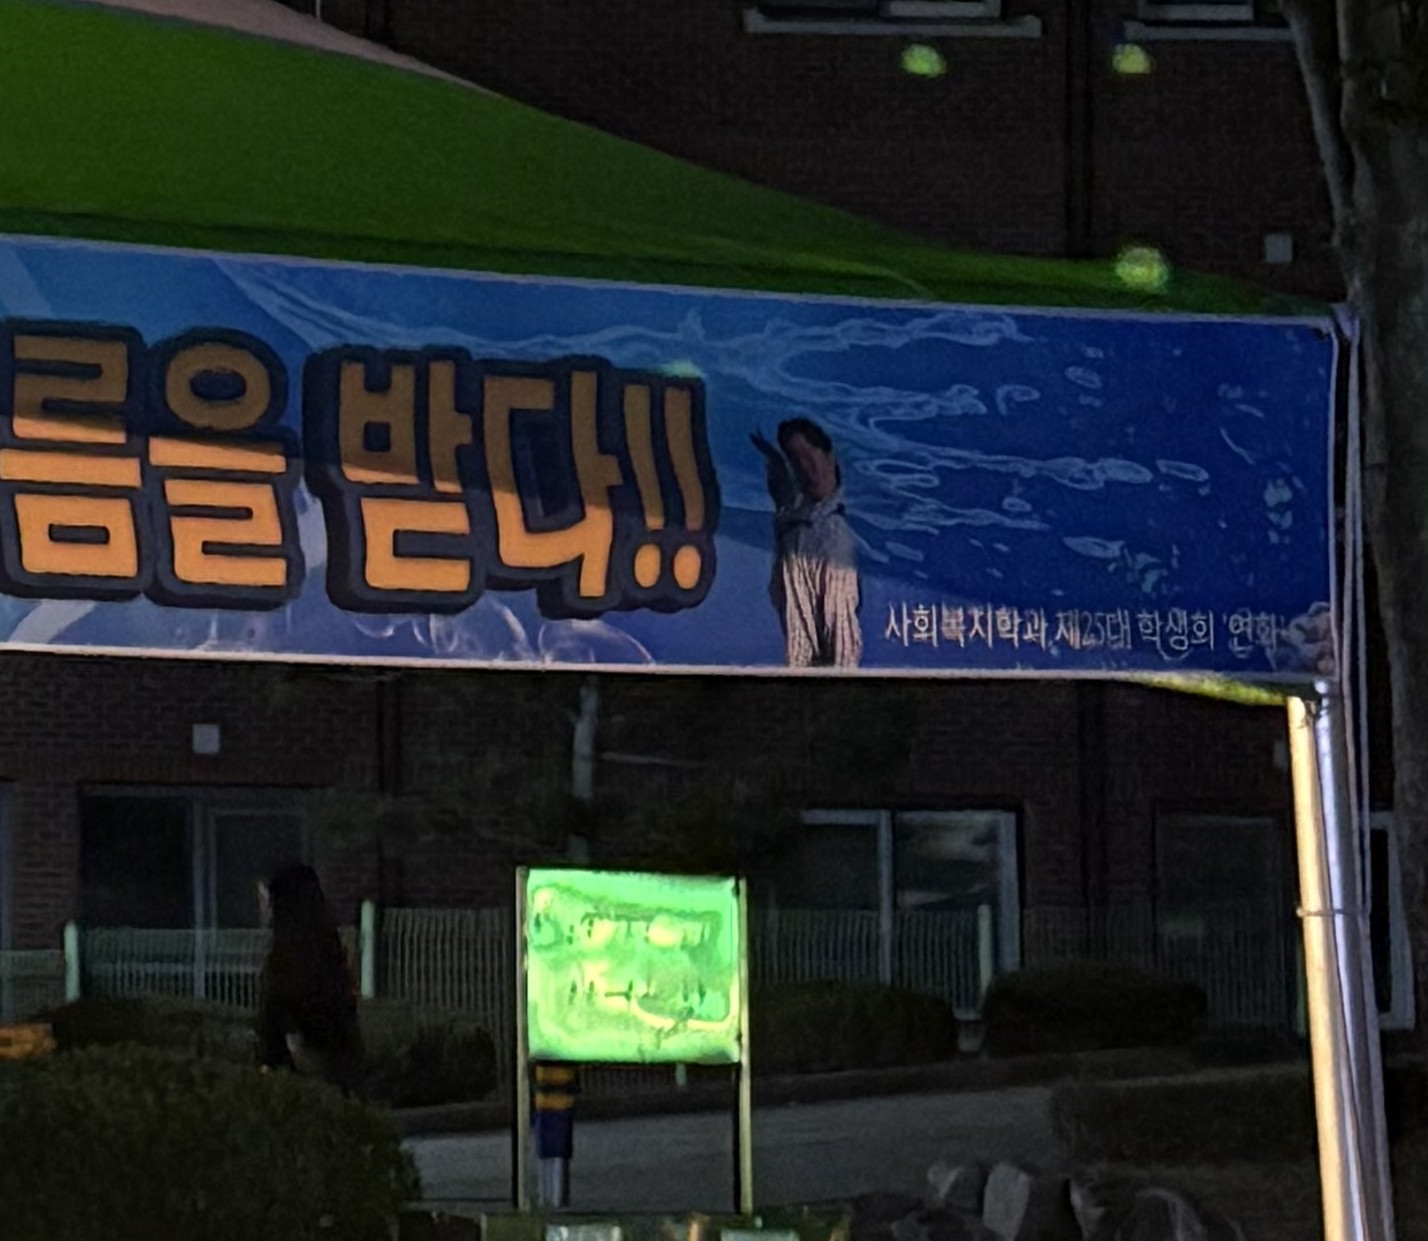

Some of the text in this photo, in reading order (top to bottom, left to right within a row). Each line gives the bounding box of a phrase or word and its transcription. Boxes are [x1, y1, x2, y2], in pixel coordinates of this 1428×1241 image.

[332, 346, 715, 608] 받다!!
[884, 602, 1048, 650] 사회복지학과
[1054, 607, 1132, 650] 제25대
[1135, 607, 1214, 660] 학생회
